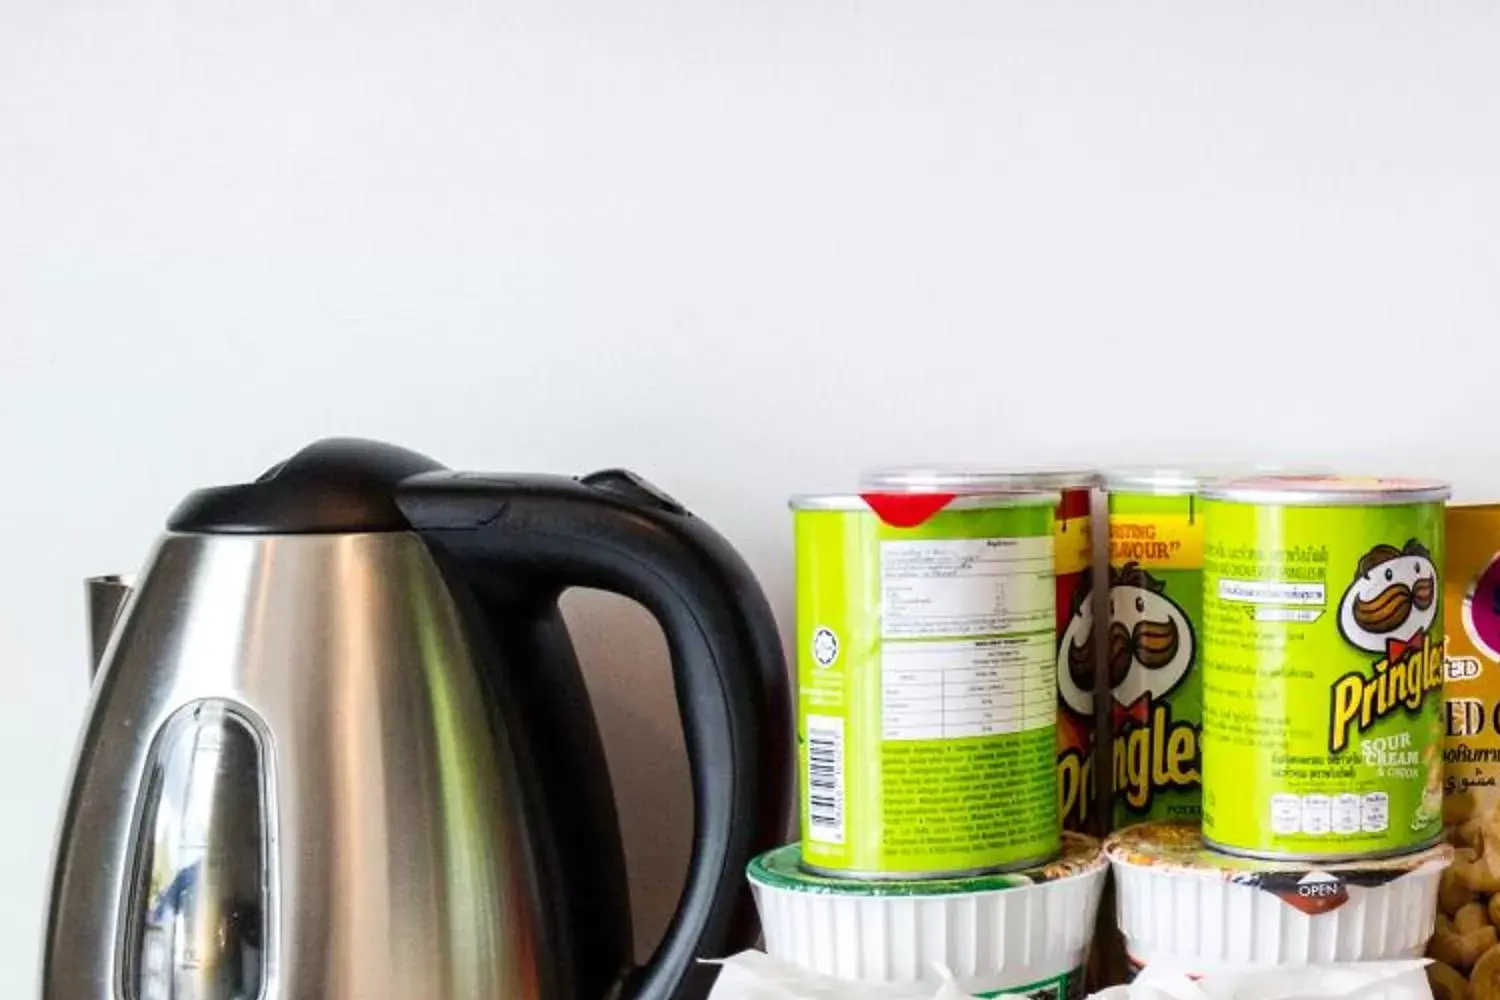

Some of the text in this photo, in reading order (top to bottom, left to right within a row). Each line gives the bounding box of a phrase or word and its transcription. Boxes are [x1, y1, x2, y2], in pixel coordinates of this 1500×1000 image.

[1361, 732, 1412, 753] SOUR
[1365, 750, 1419, 767] CREAM
[1299, 883, 1338, 897] OPEN
